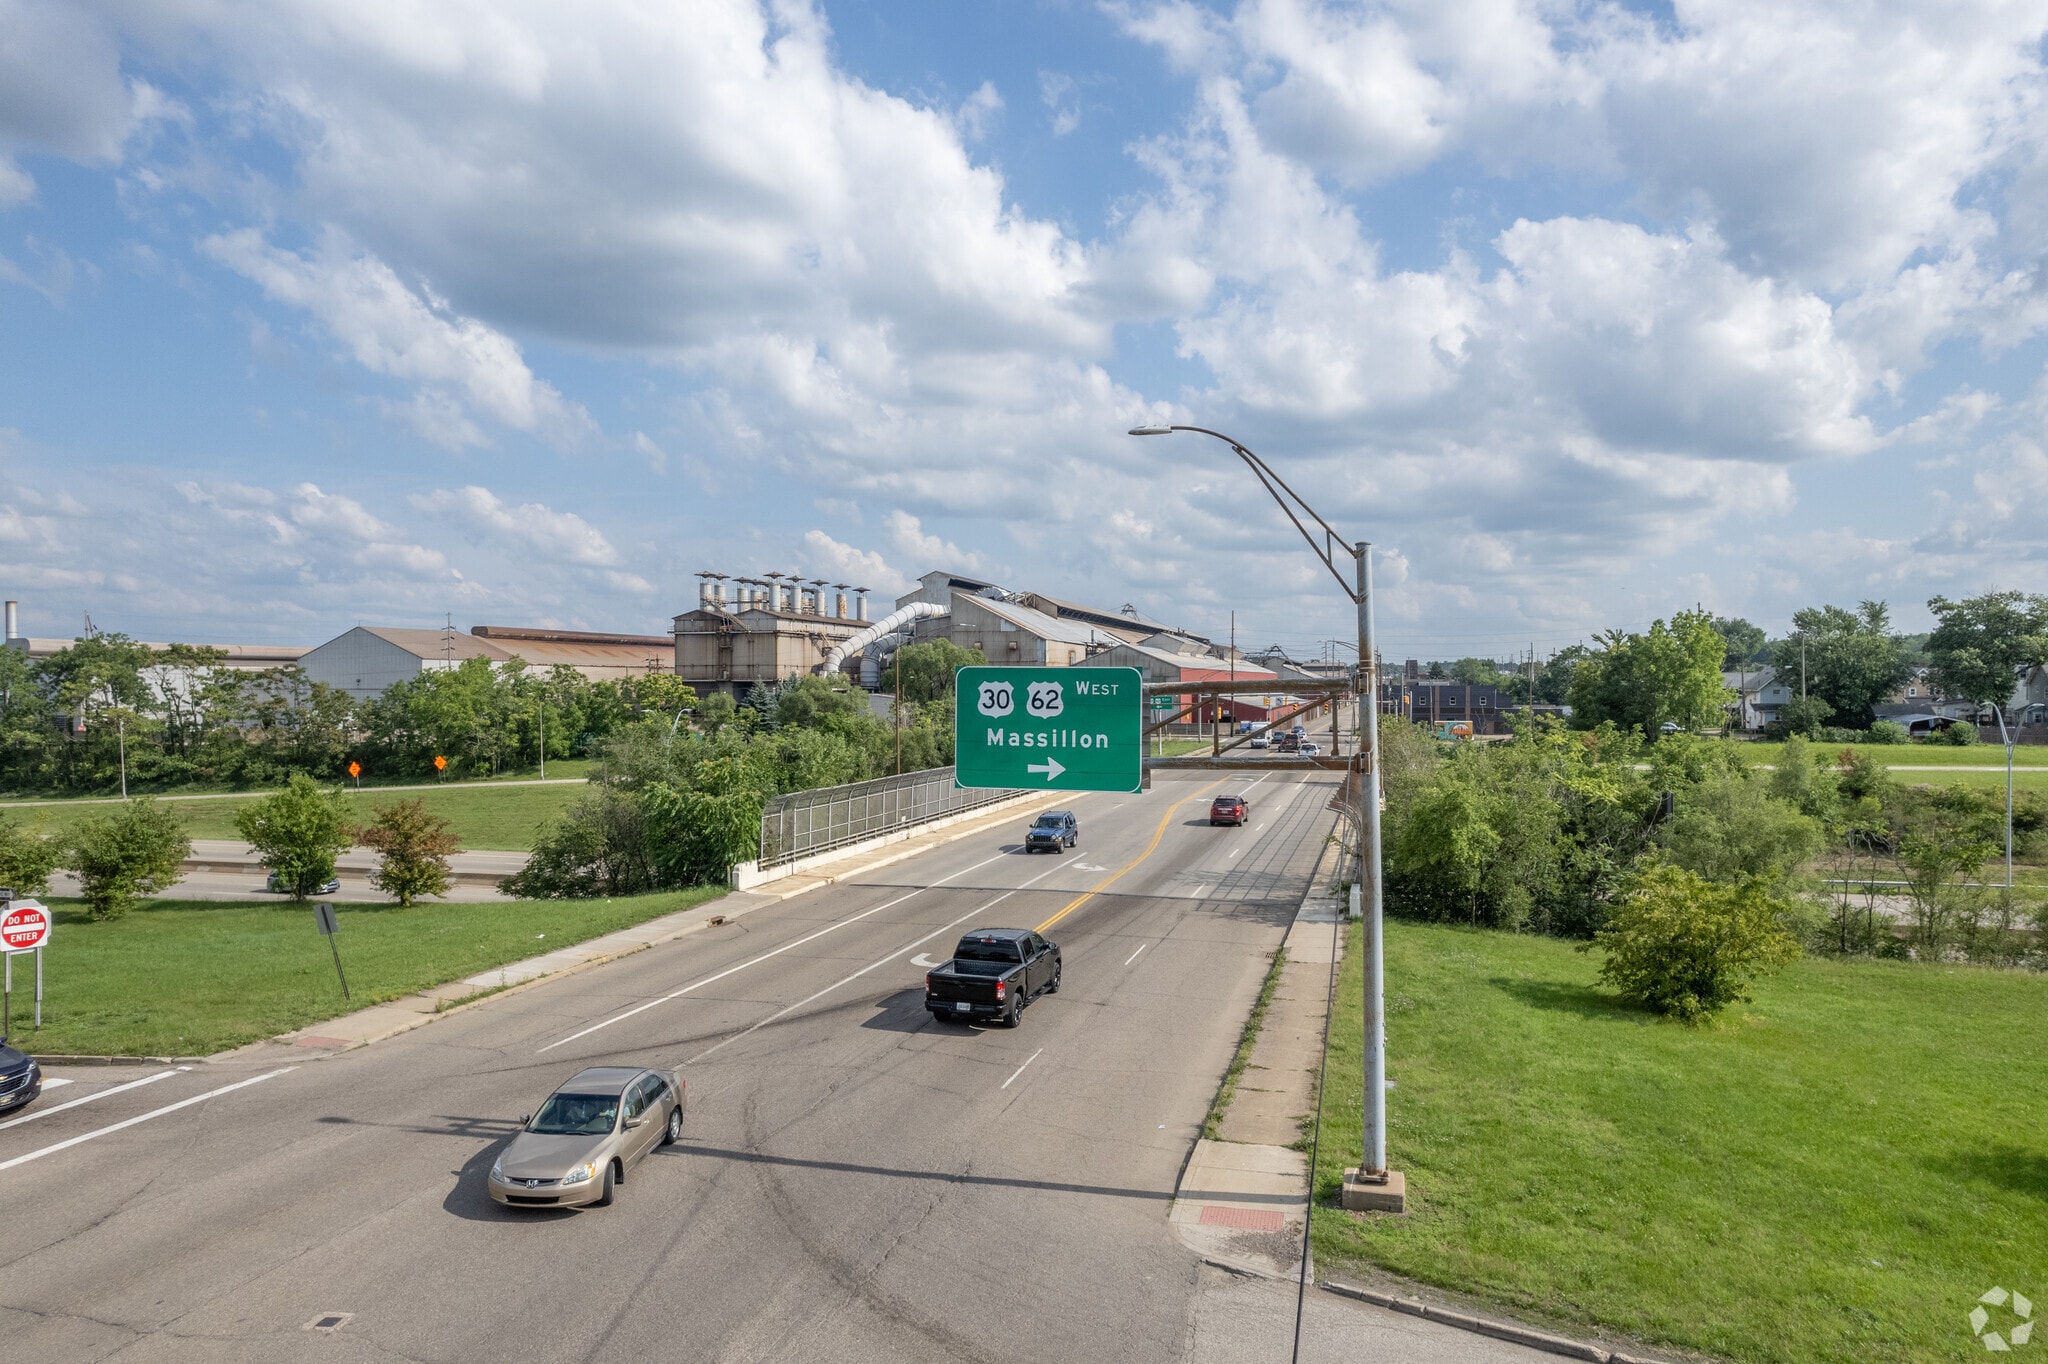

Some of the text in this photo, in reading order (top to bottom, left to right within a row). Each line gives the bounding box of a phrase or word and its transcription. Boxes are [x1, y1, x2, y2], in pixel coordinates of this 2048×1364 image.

[982, 689, 1010, 710] 30
[1031, 689, 1060, 710] 62
[987, 728, 1109, 748] Massillon
[8, 913, 41, 925] DO NOT
[10, 932, 38, 943] ENTER
